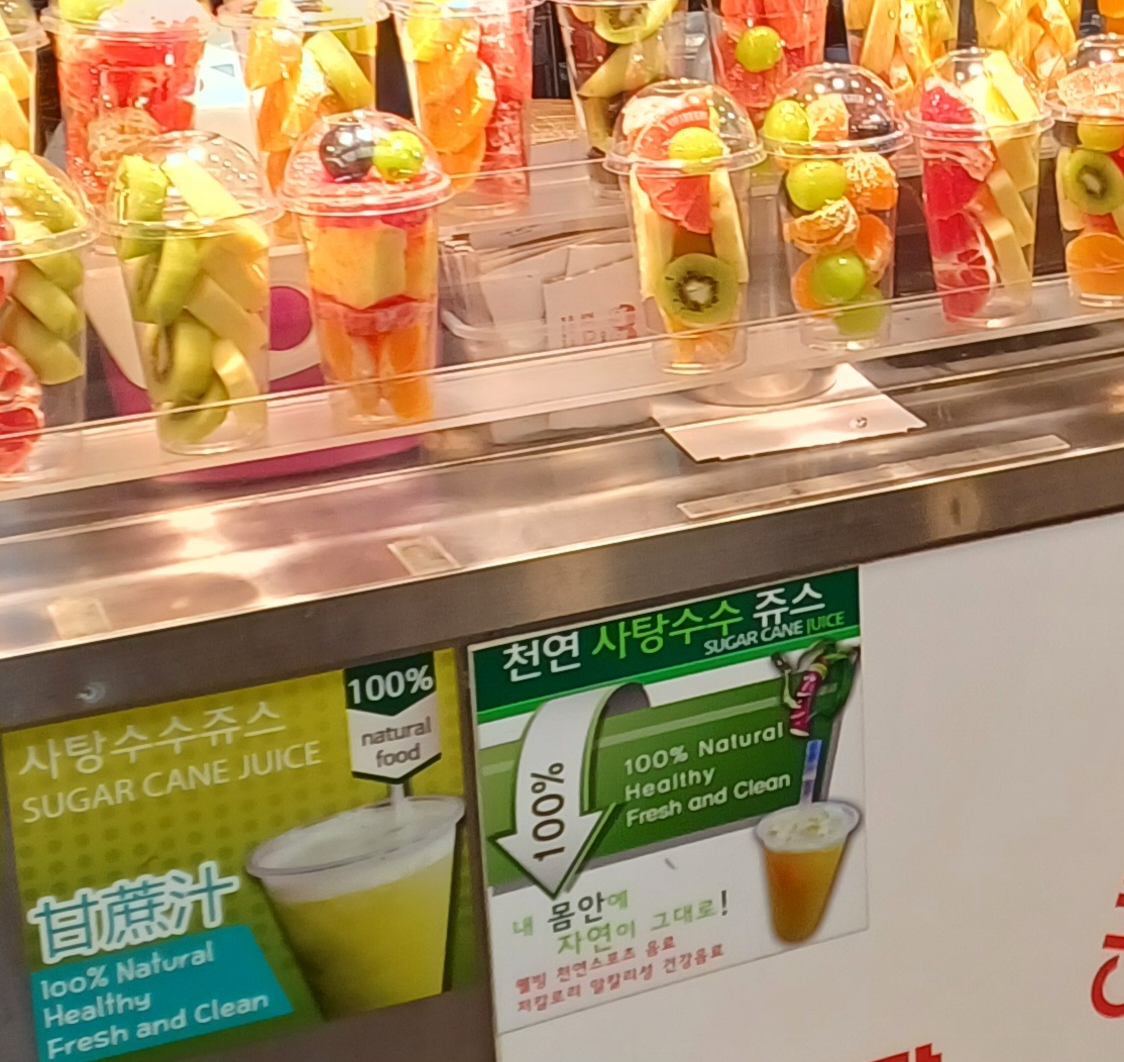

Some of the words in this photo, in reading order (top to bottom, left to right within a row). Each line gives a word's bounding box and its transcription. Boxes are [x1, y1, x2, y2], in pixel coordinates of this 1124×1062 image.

[503, 630, 581, 683] 천연
[591, 599, 743, 659] 사탕수수
[752, 582, 827, 629] 쥬스
[704, 630, 759, 657] SUGAR
[760, 620, 804, 642] CANE
[806, 611, 845, 637] JUICE
[348, 664, 435, 705] 100%
[18, 701, 287, 780] 사탕수수쥬스
[361, 716, 433, 747] natural
[376, 743, 421, 768] food
[624, 741, 689, 776] 100%
[698, 722, 784, 758] Natural
[22, 778, 135, 824] SUGAR
[143, 761, 230, 798] CANE
[238, 741, 322, 780] JUICE
[624, 766, 716, 801] Healthy
[626, 797, 682, 828] Fresh
[688, 786, 728, 812] and
[733, 772, 791, 799] Clean
[531, 761, 566, 862] 100%
[28, 860, 240, 964] 甘蔗汁
[117, 940, 214, 985] Natural
[556, 919, 637, 956] 자연이
[43, 993, 151, 1028] Healthy
[47, 1024, 129, 1060] Fresh
[136, 1010, 187, 1038] and
[194, 992, 269, 1026] Clean
